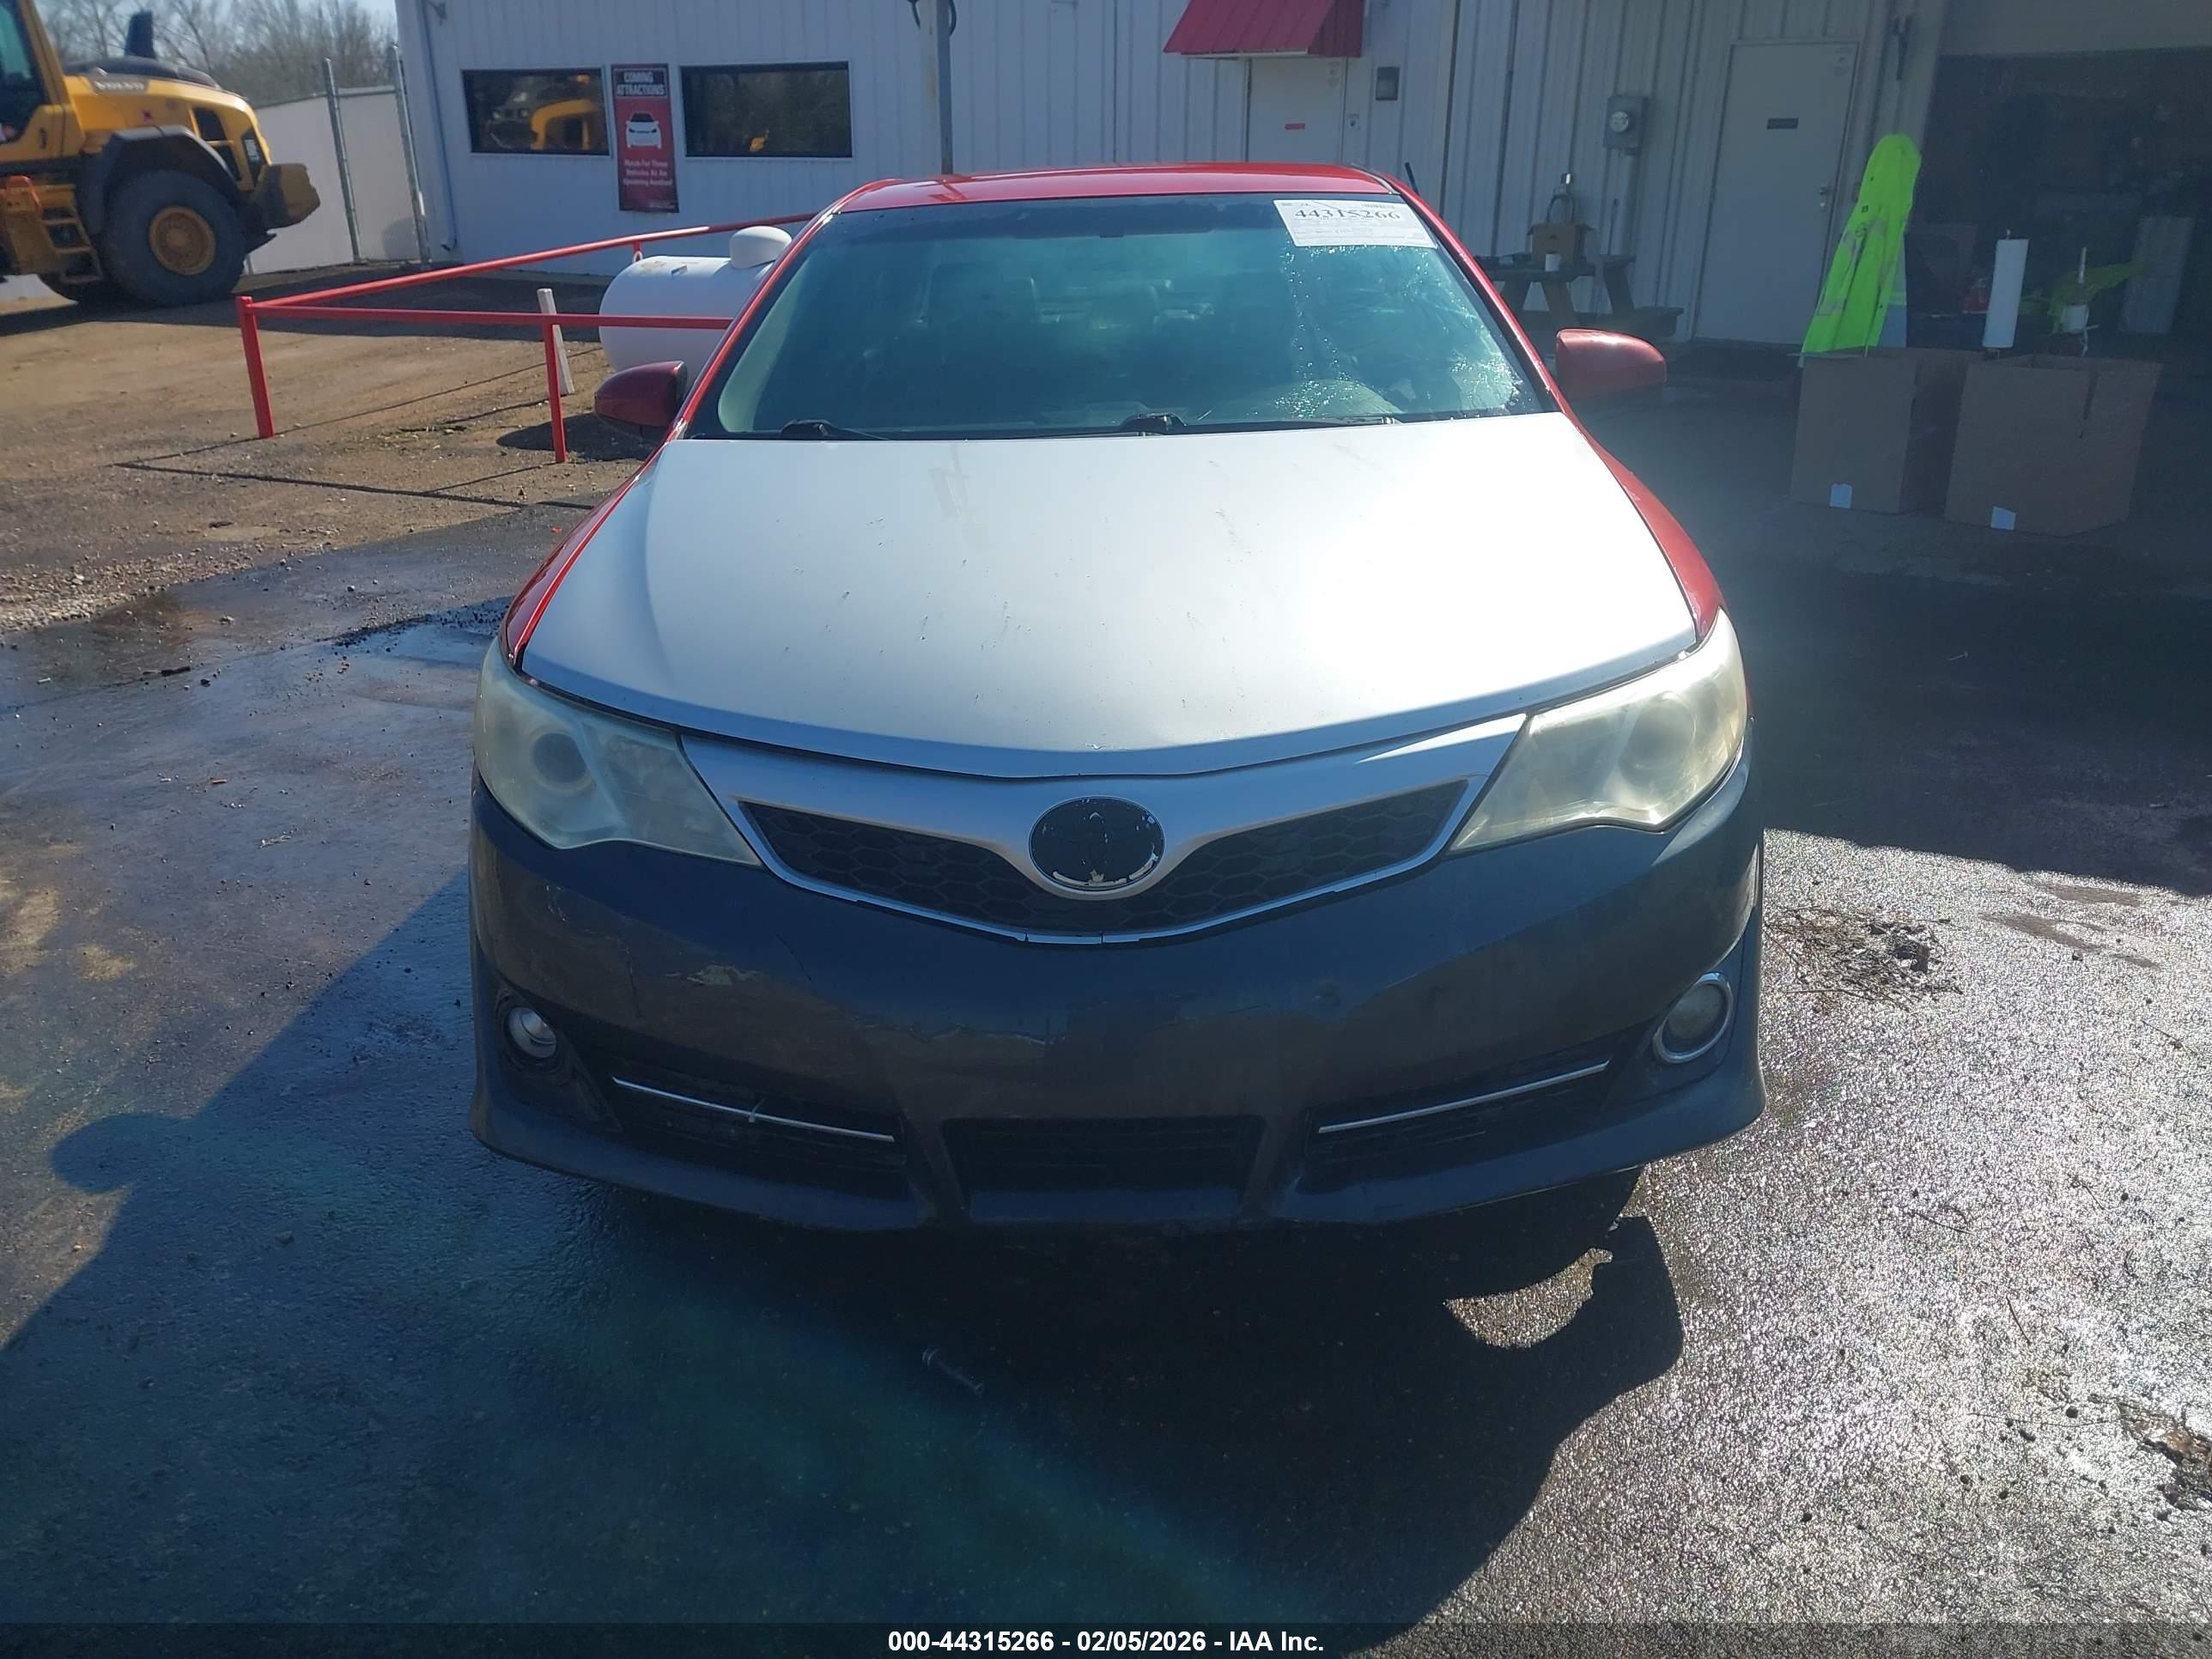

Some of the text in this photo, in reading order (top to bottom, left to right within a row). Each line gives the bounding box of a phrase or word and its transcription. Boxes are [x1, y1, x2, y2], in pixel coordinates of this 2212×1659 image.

[623, 71, 653, 83] COMING
[617, 84, 665, 96] ATTRACTIONS
[1294, 209, 1401, 220] 44315266
